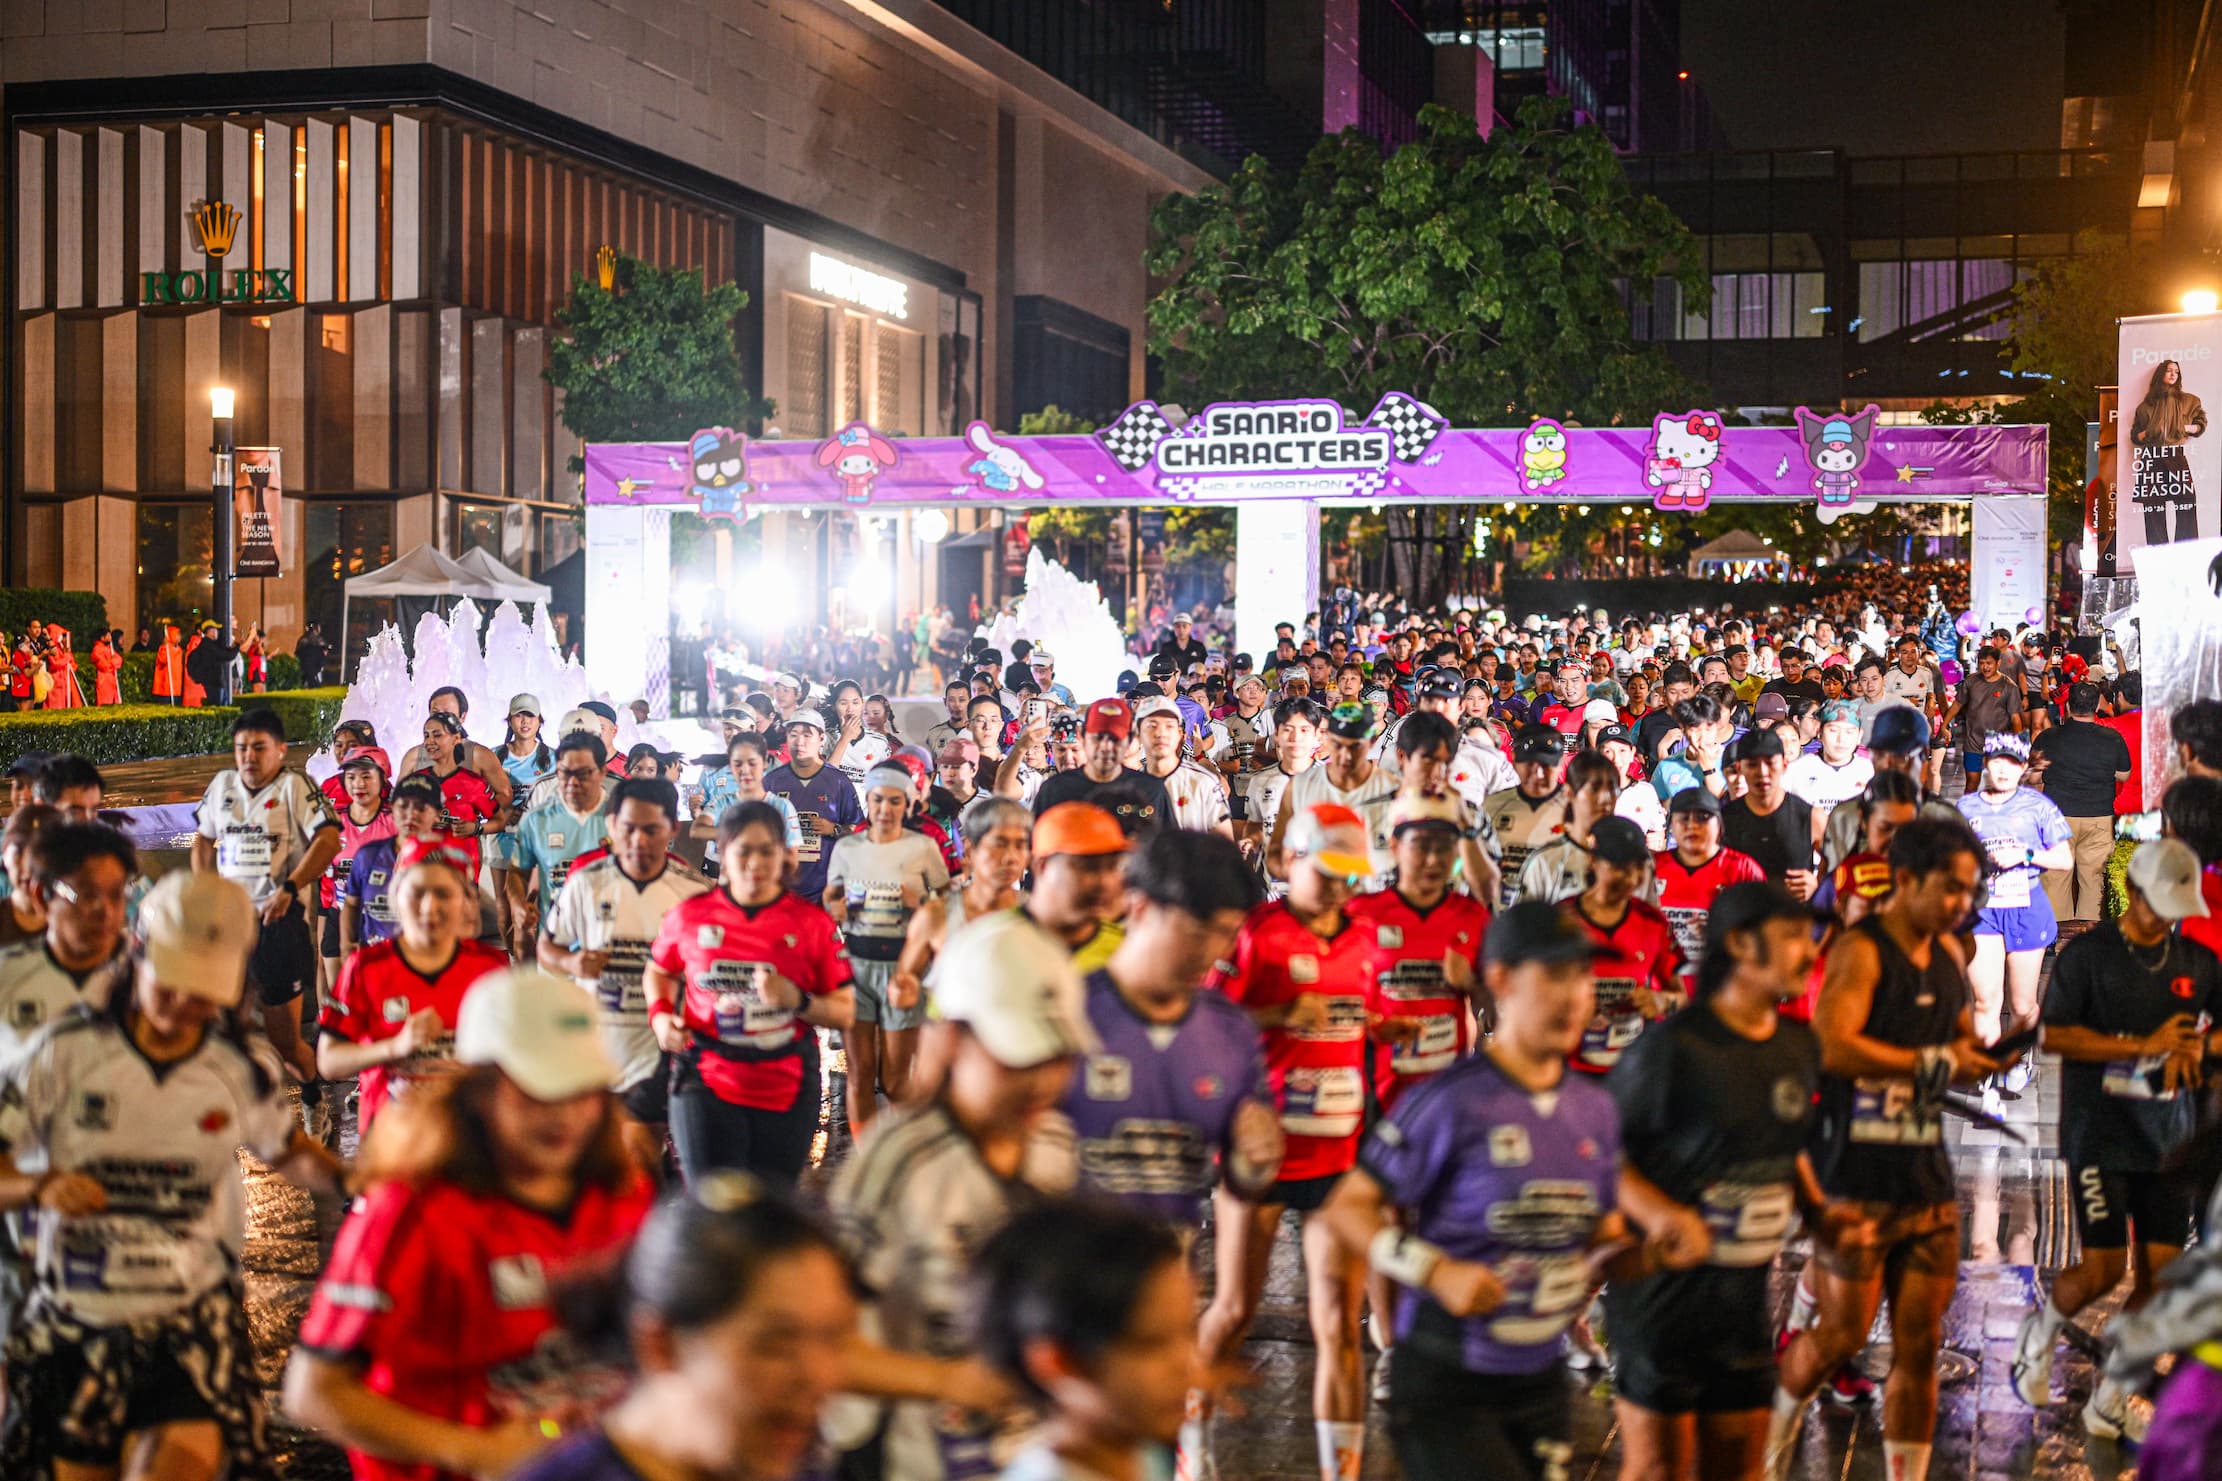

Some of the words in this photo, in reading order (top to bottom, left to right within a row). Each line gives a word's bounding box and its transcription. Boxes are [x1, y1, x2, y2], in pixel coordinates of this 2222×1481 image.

[141, 270, 296, 303] ROLEX
[2131, 344, 2212, 365] Parade
[1164, 439, 1383, 467] CHARACTERS
[2133, 445, 2198, 459] PALETTE
[240, 463, 275, 473] Parade
[2131, 459, 2153, 472] OF
[1250, 479, 1343, 490] MARATHON
[2132, 472, 2163, 485] THE
[2132, 484, 2194, 497] SEASON
[241, 531, 270, 539] SEASON
